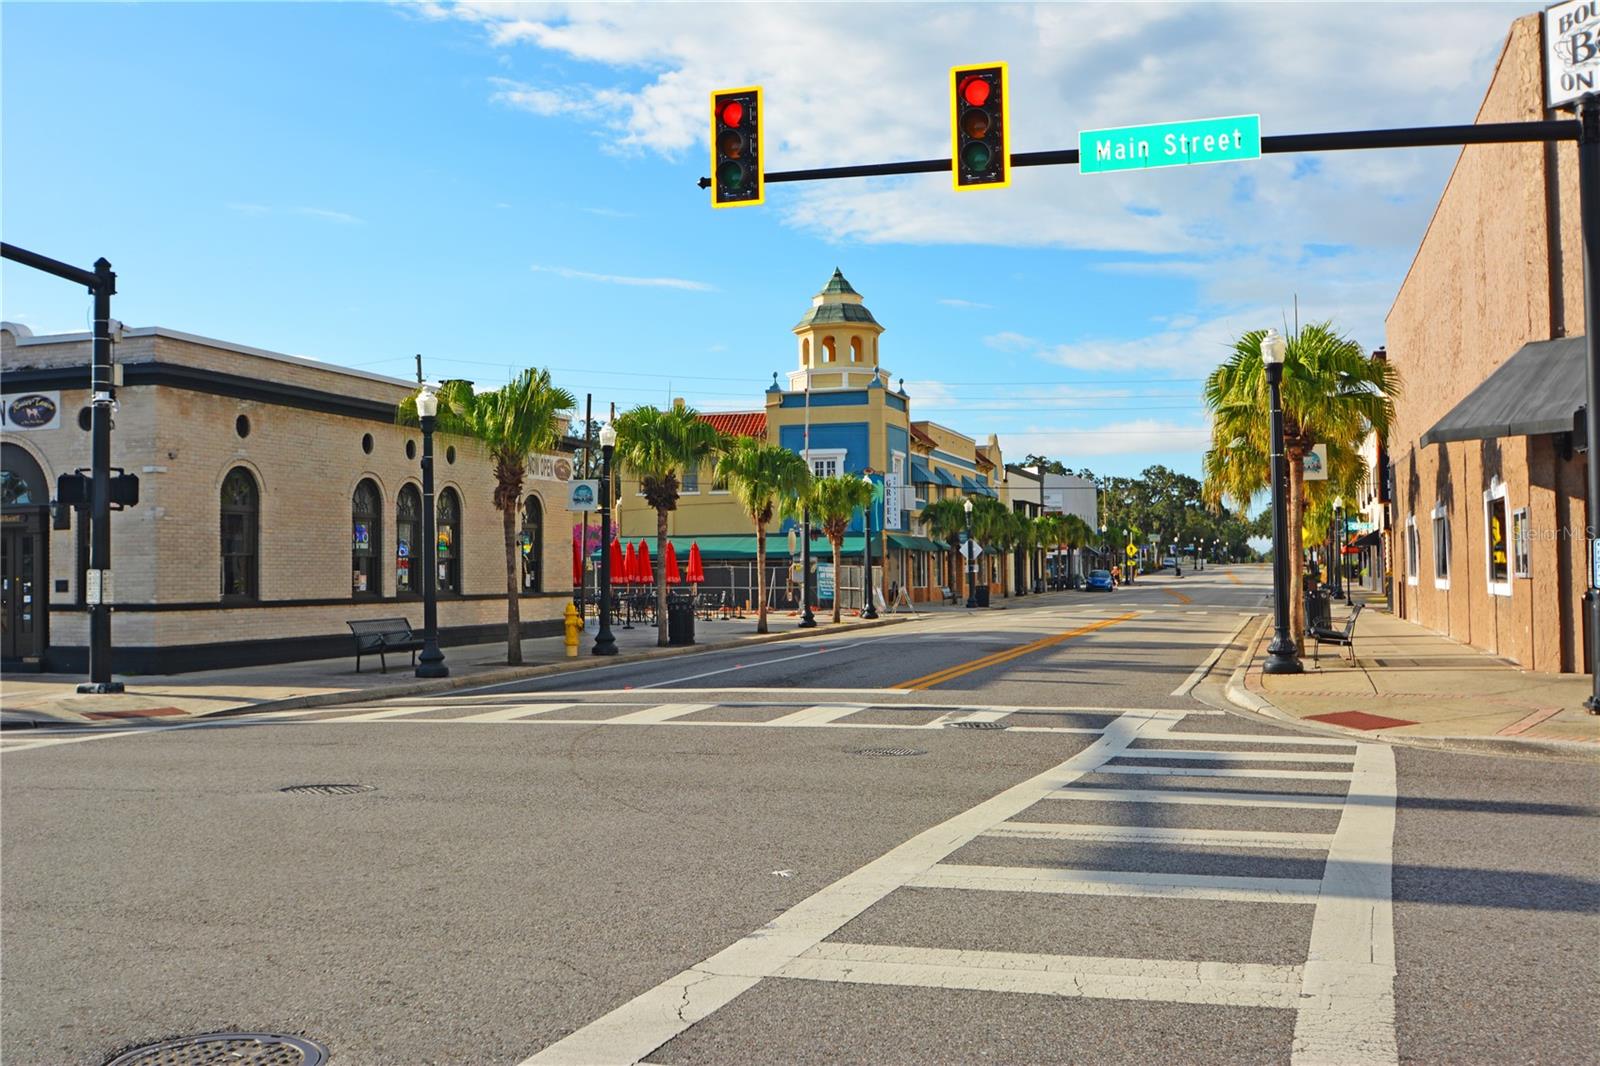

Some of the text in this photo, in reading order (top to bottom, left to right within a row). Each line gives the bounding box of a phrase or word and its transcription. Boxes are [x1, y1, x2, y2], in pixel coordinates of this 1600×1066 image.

[1560, 71, 1594, 91] ON
[1096, 128, 1242, 161] Main Street
